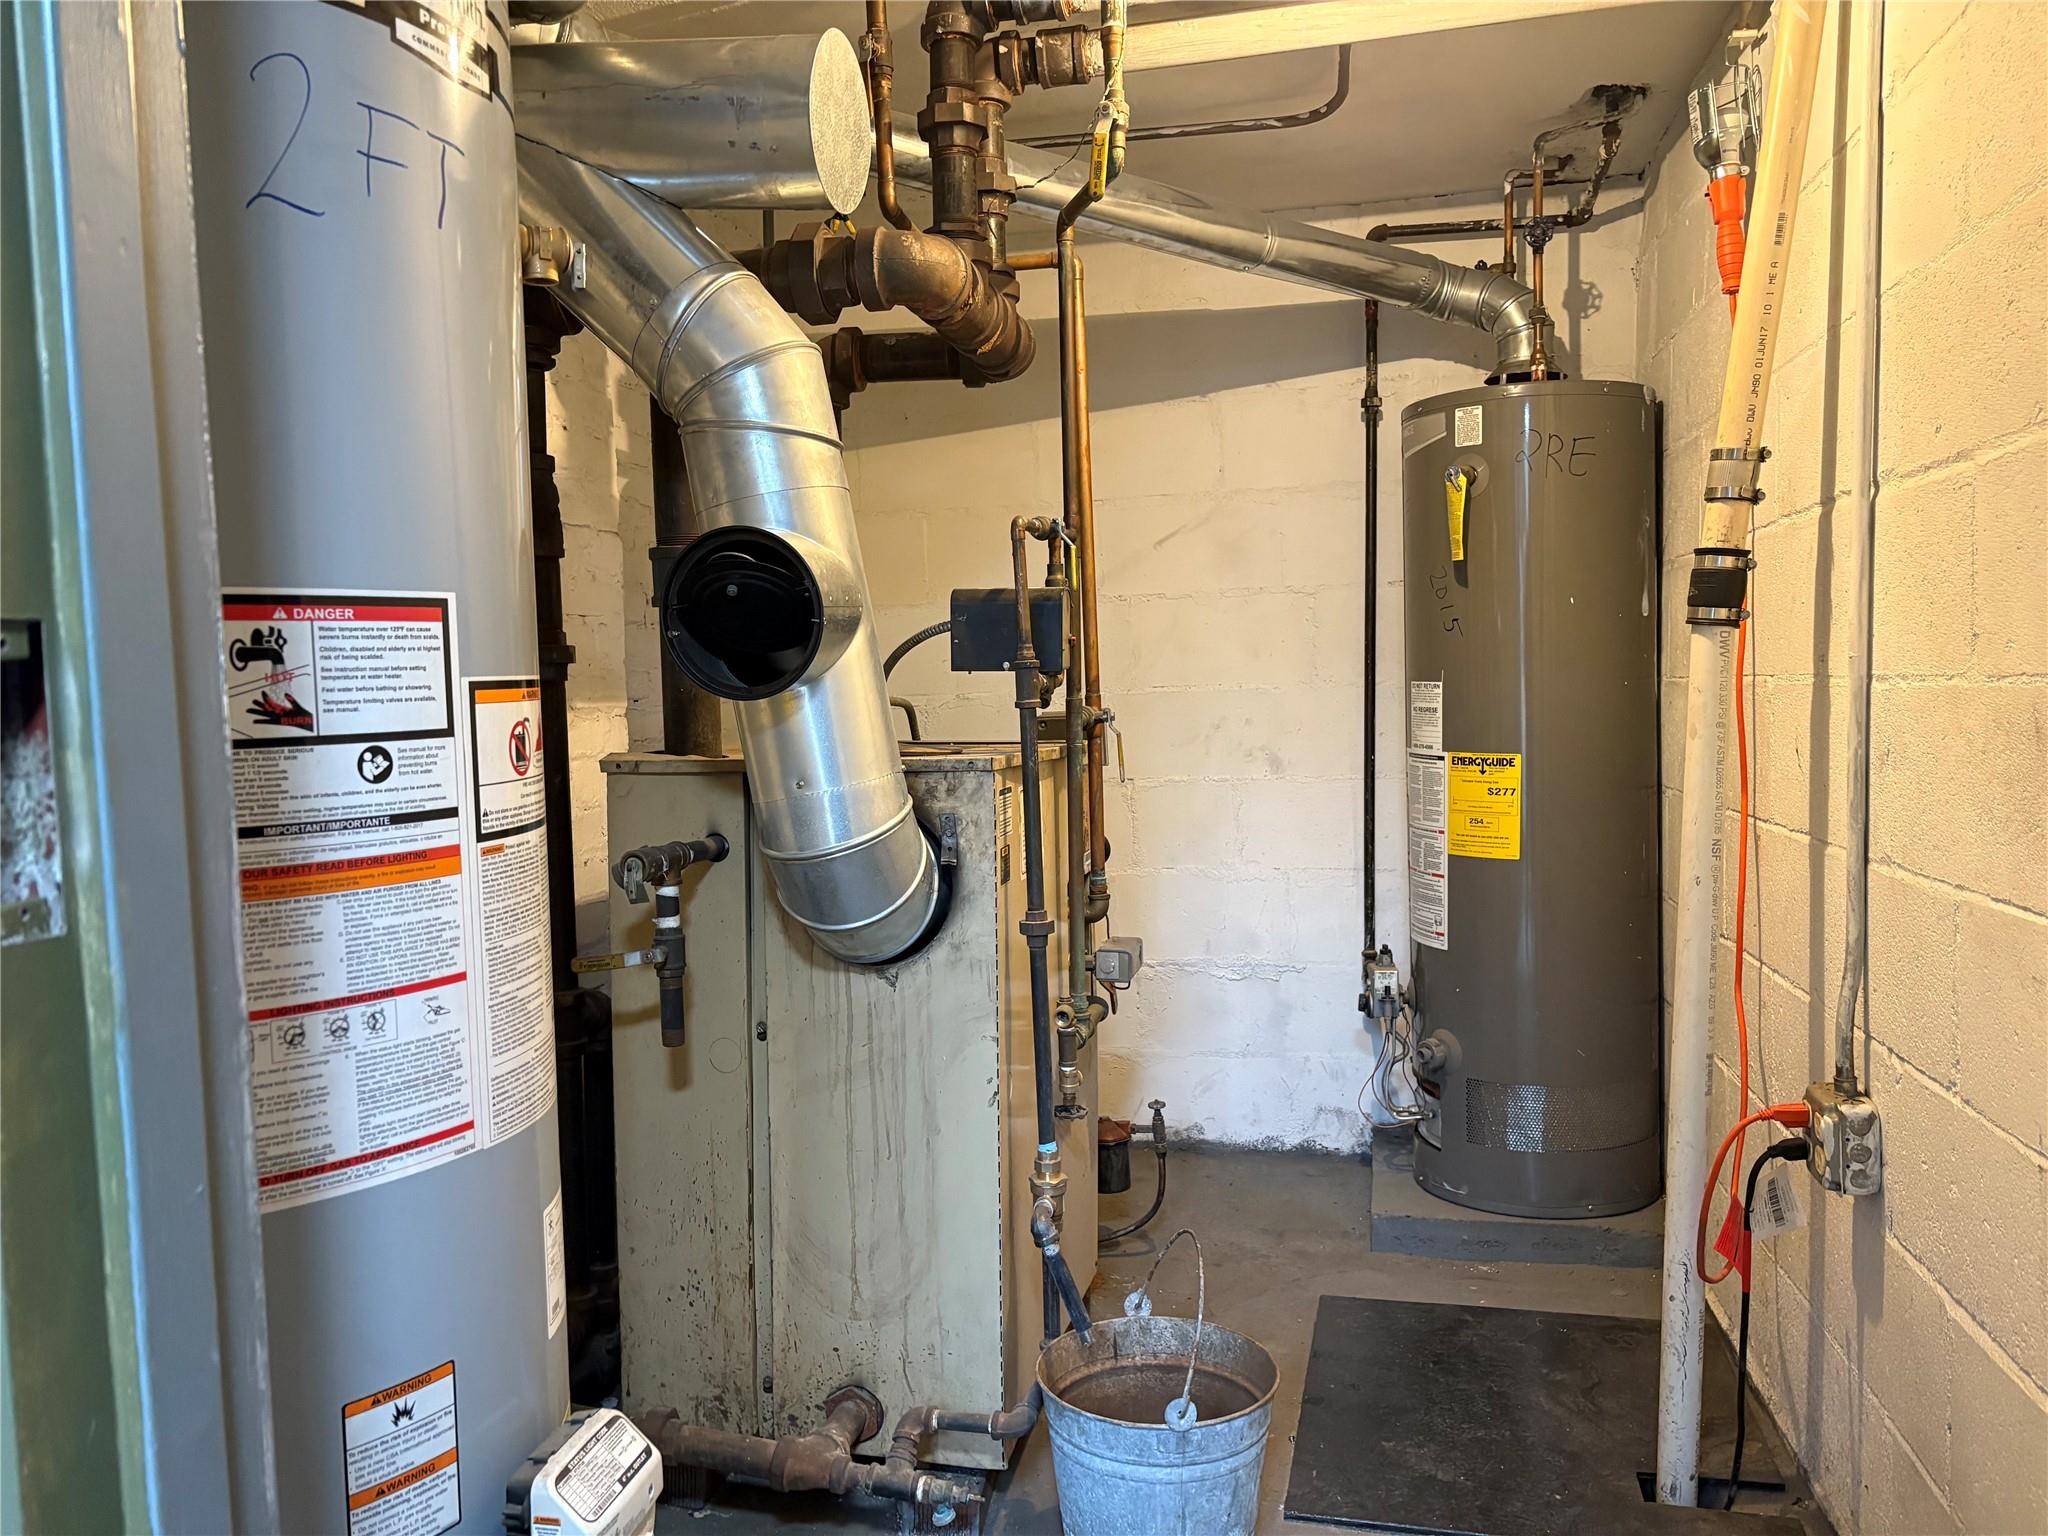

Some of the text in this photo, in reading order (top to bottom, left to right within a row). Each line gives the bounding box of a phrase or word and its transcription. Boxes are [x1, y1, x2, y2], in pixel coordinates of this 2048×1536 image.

[246, 52, 465, 230] 2 FT
[1770, 261, 1780, 269] A
[1768, 272, 1778, 285] ME
[1754, 326, 1769, 369] 01JUN17
[1750, 373, 1762, 399] JM90
[1746, 404, 1757, 423] DWV
[1429, 565, 1464, 638] 2015
[293, 607, 355, 620] DANGER
[338, 626, 375, 634] temperature
[1719, 630, 1731, 659] DWV
[1718, 706, 1728, 720] PSI
[398, 762, 424, 770] preventing
[1451, 755, 1516, 768] ENERGYGUIDE
[1716, 744, 1726, 768] ASTM
[1487, 786, 1516, 796] $277
[1714, 790, 1724, 813] ASTM
[263, 816, 391, 837] IMPORTANT/IMPORTANTE
[1469, 817, 1484, 825] 254
[1712, 838, 1722, 862] NSF
[271, 863, 313, 877] SAFETY
[315, 860, 344, 873] READ
[346, 856, 388, 869] BEFORE
[388, 851, 428, 864] LIGHTING
[340, 890, 360, 899] WATER
[382, 884, 404, 894] PURGED
[404, 882, 418, 890] FROM
[269, 988, 395, 1017] LIGHTING INSTRUCTIONS
[306, 1165, 325, 1177] OFF
[330, 1159, 351, 1171] GAS
[354, 1154, 368, 1166] TO
[369, 1140, 420, 1160] APPLIANCE
[382, 1374, 432, 1401] WARNING
[357, 1444, 378, 1455] reduce
[390, 1434, 402, 1443] risk
[410, 1419, 436, 1436] explosion
[443, 1410, 452, 1418] fire
[386, 1462, 436, 1492] WARNING
[360, 1502, 382, 1515] reduce
[382, 1498, 392, 1506] the
[392, 1492, 404, 1502] risk
